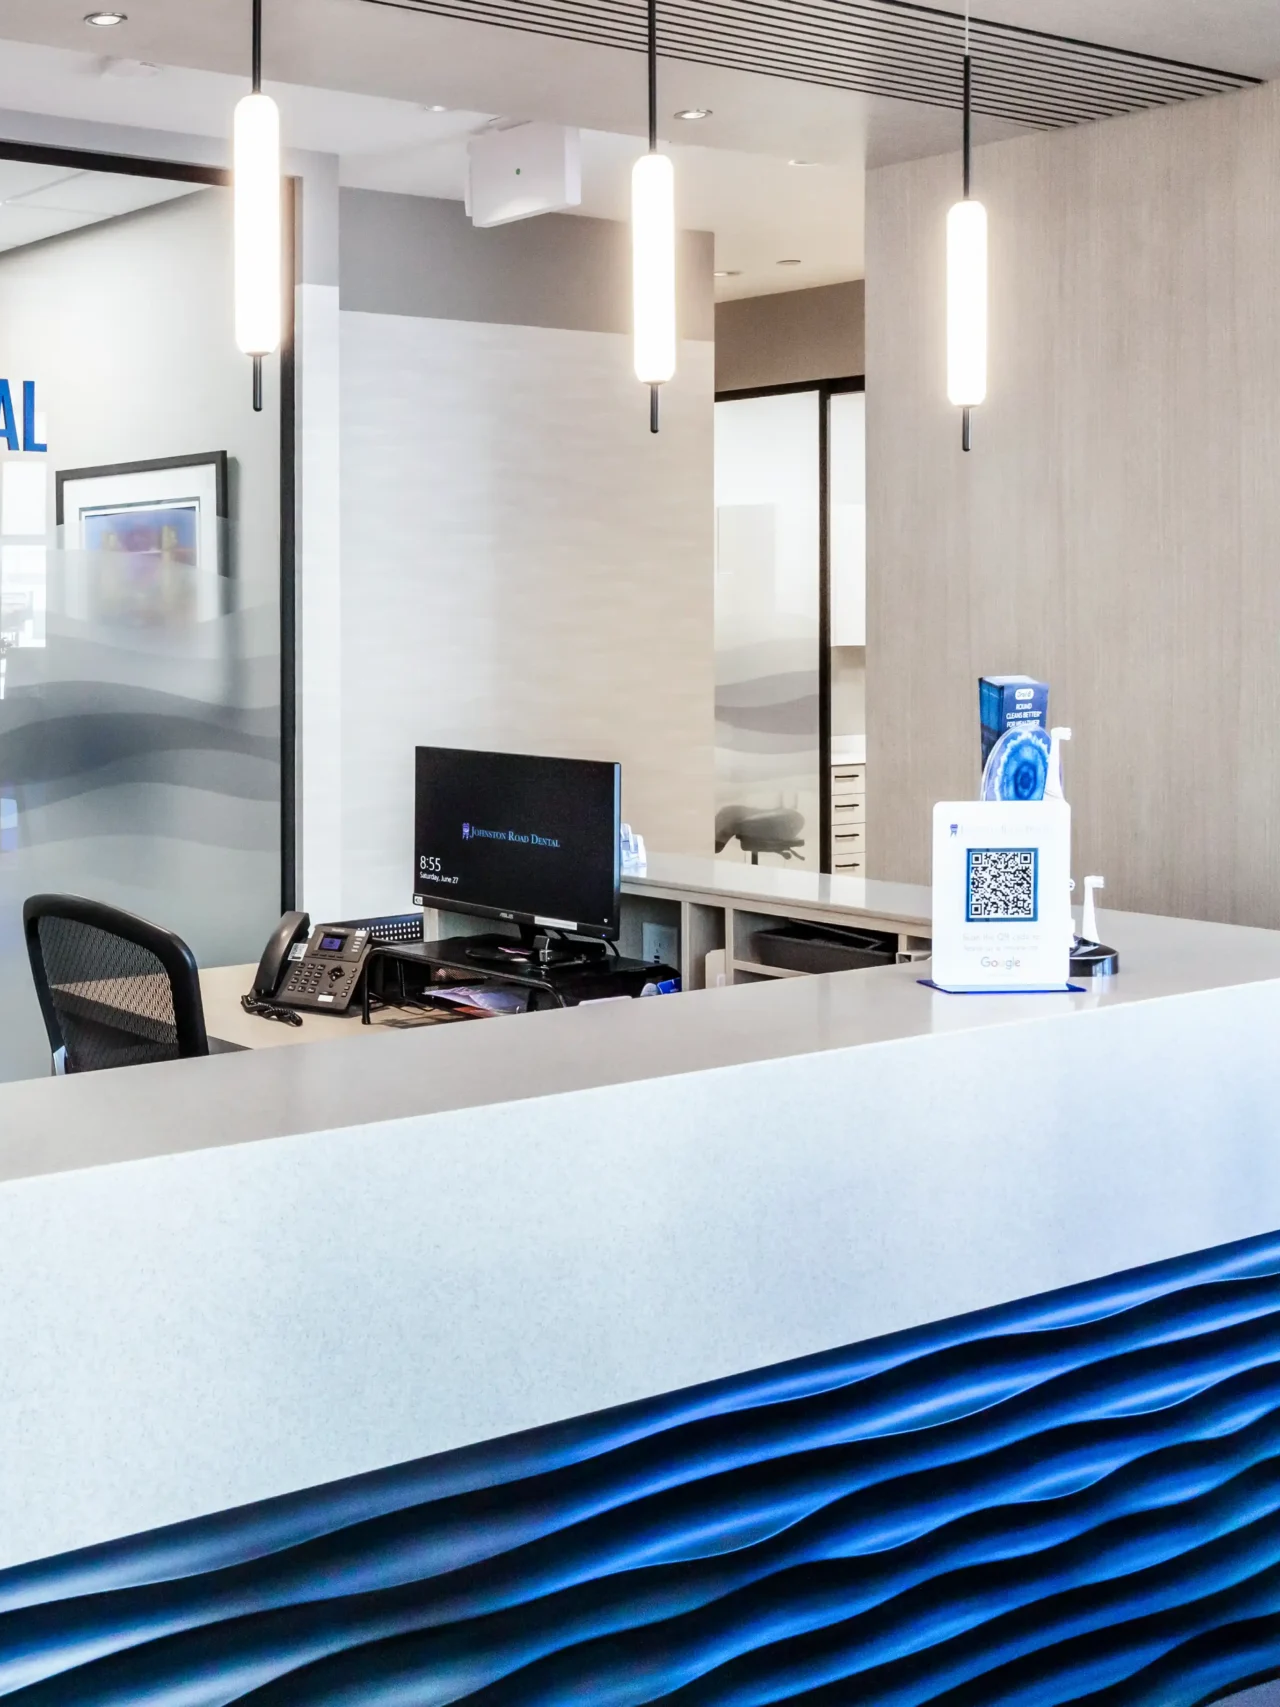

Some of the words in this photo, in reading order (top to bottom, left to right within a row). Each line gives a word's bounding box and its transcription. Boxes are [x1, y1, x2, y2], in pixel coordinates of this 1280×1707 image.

[470, 826, 506, 840] JOHNSTON
[508, 831, 529, 843] ROAD
[531, 834, 560, 848] DENTAL
[420, 855, 441, 872] 8:55
[420, 871, 440, 883] Saturday,
[441, 875, 452, 883] June
[452, 876, 459, 884] 27
[980, 956, 1020, 970] Gogle
